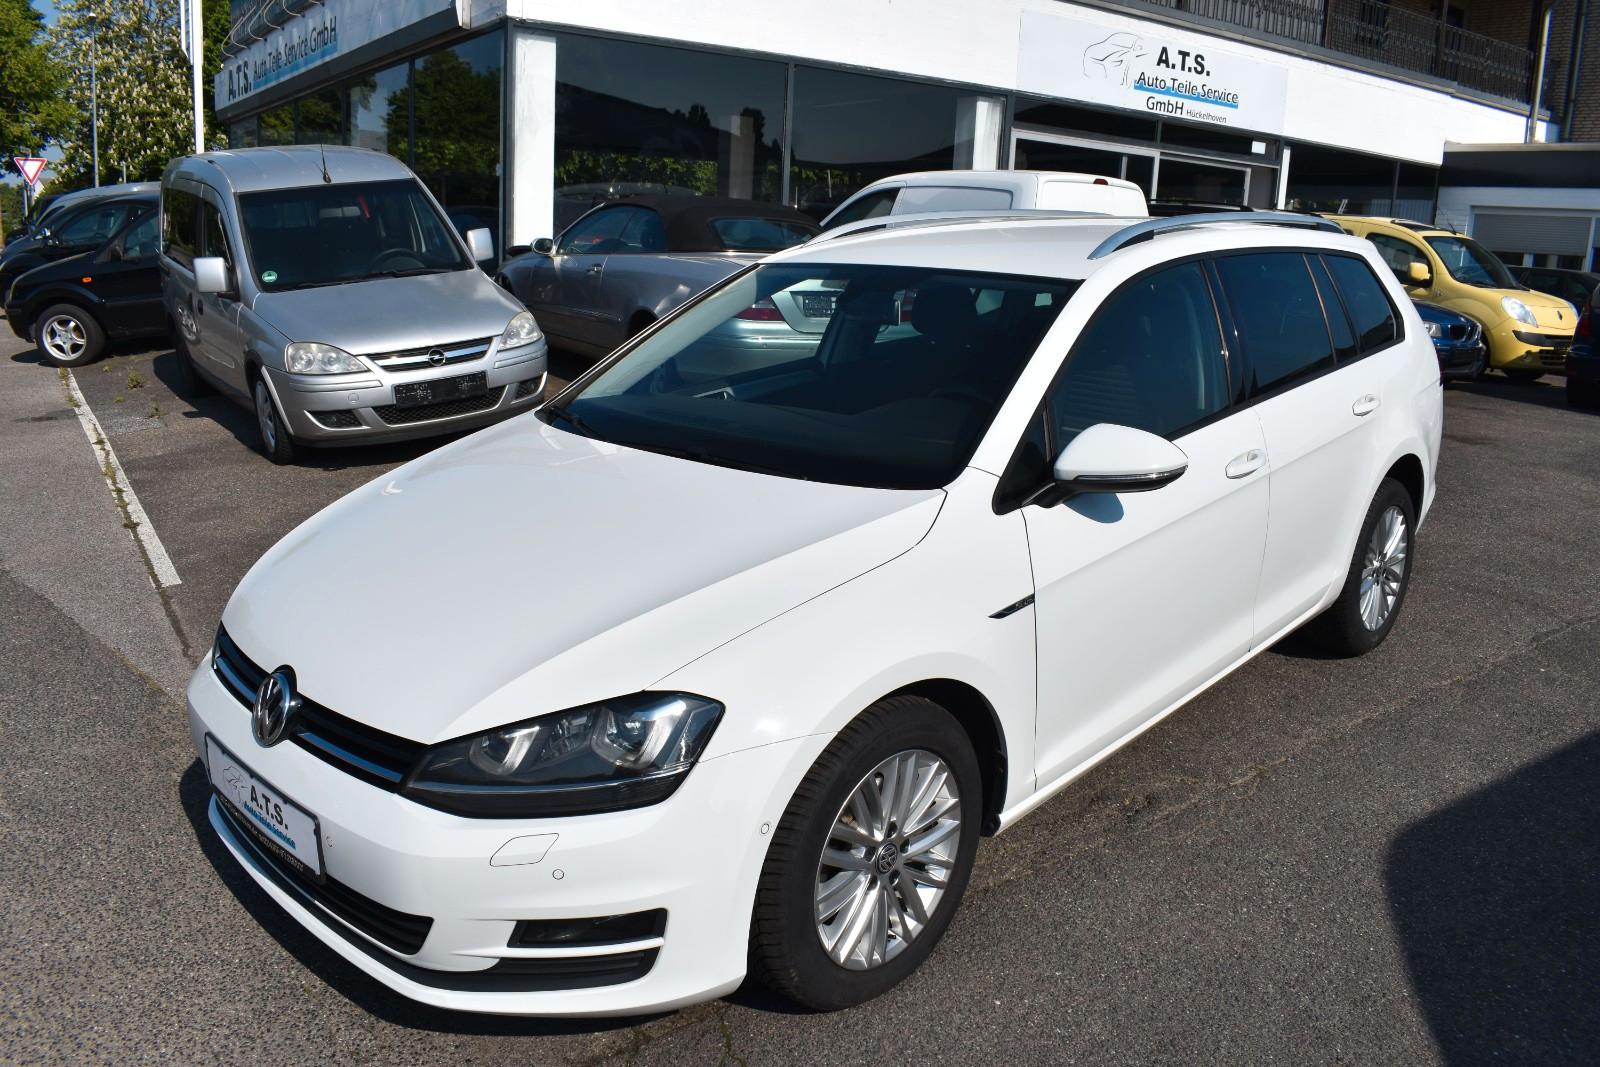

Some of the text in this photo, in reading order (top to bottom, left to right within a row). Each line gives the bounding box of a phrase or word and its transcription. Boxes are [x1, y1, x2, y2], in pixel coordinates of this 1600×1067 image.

[228, 60, 252, 101] A.T.S.
[283, 36, 308, 66] Service
[310, 16, 337, 53] GmbH
[1156, 46, 1211, 77] A.T.S.
[1136, 71, 1239, 104] Auto Teile Service
[1146, 96, 1185, 116] GmbH
[250, 784, 289, 831] A.T.S.
